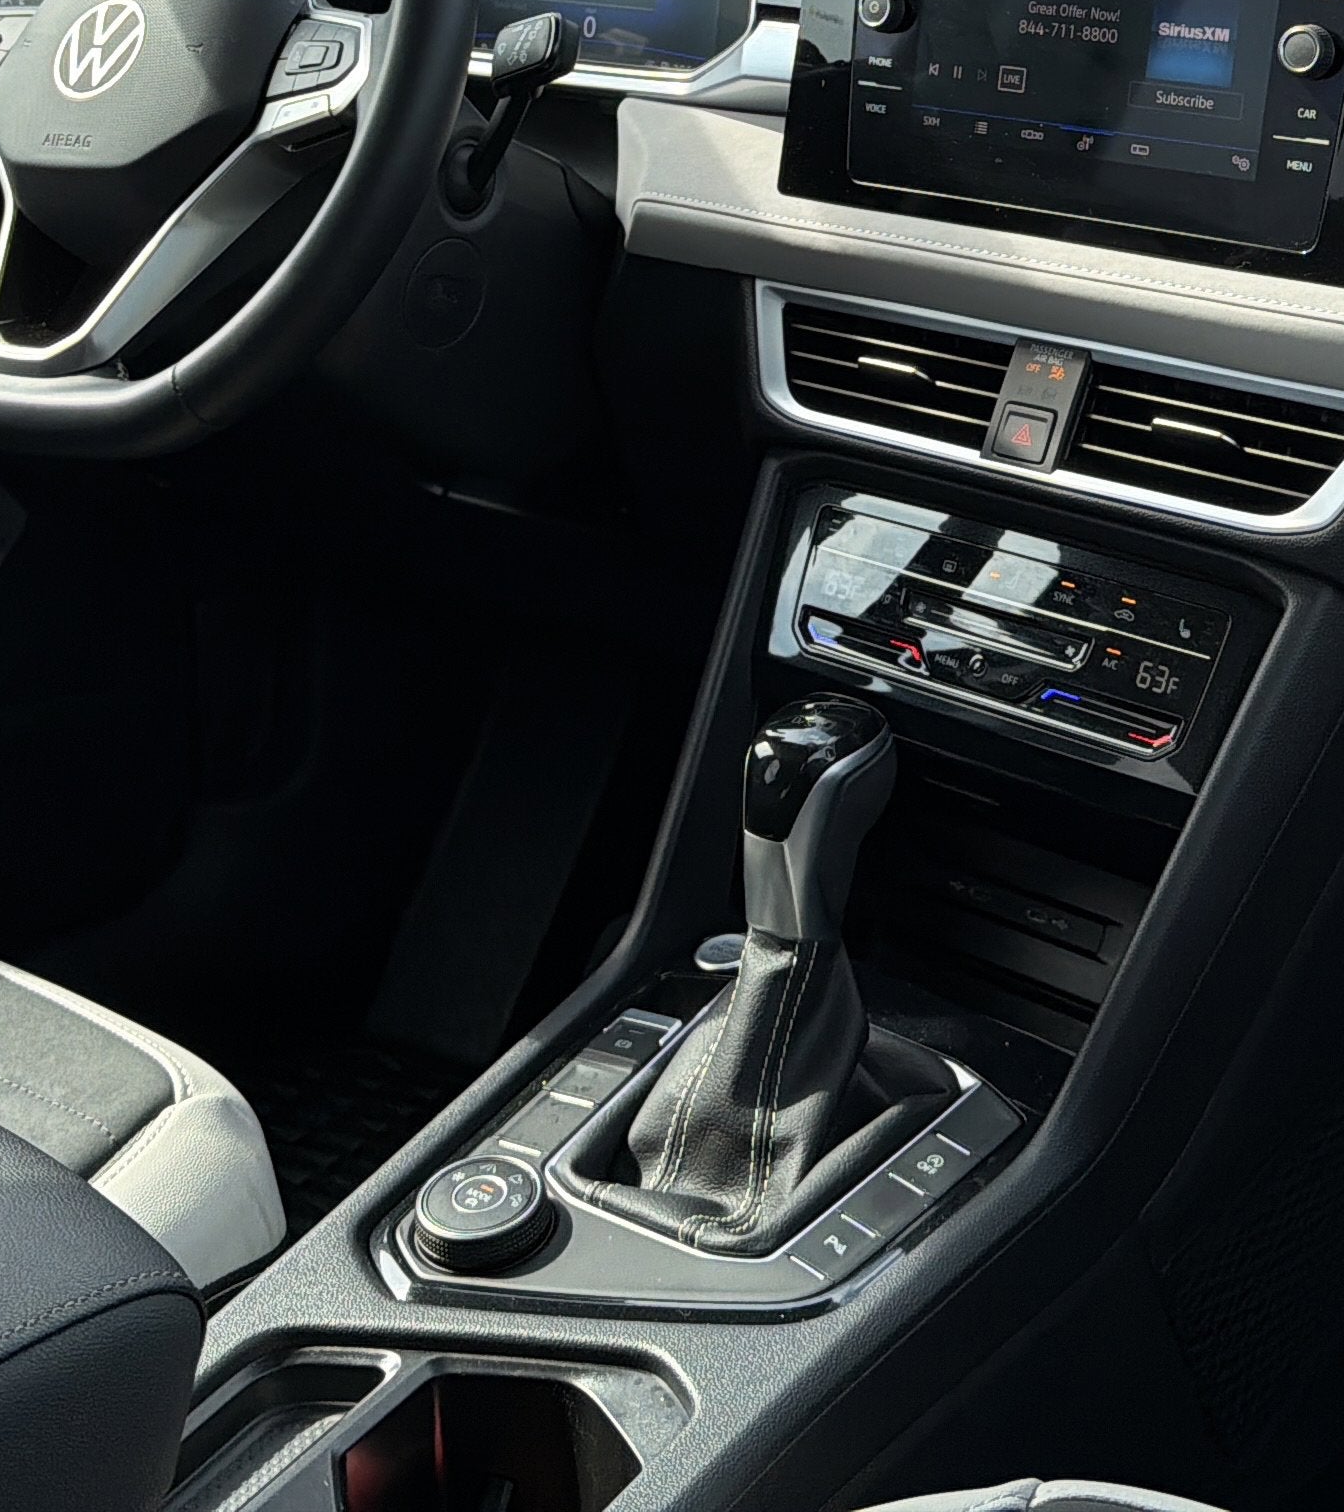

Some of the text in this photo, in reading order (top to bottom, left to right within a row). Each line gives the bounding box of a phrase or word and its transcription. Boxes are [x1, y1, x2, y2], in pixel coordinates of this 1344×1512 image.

[1028, 0, 1121, 22] Great Offer Now!
[583, 15, 597, 38] 0
[1018, 19, 1118, 44] 844-711-8800
[1158, 22, 1230, 43] SiriusXM
[868, 56, 893, 68] PHONE
[1003, 73, 1021, 85] LIVE
[1155, 90, 1215, 110] Subscribe
[865, 102, 887, 115] VOICE
[1297, 107, 1317, 120] CAR
[41, 133, 94, 149] AIRBAG
[1286, 159, 1313, 173] MENU
[1030, 343, 1074, 360] PASSENGER
[1025, 363, 1042, 374] OFF
[1047, 356, 1064, 366] BAG
[1053, 591, 1077, 607] SYNC
[934, 653, 961, 670] MENU
[1101, 658, 1119, 672] A/C
[1001, 673, 1020, 687] OFF
[916, 1160, 938, 1175] OFF
